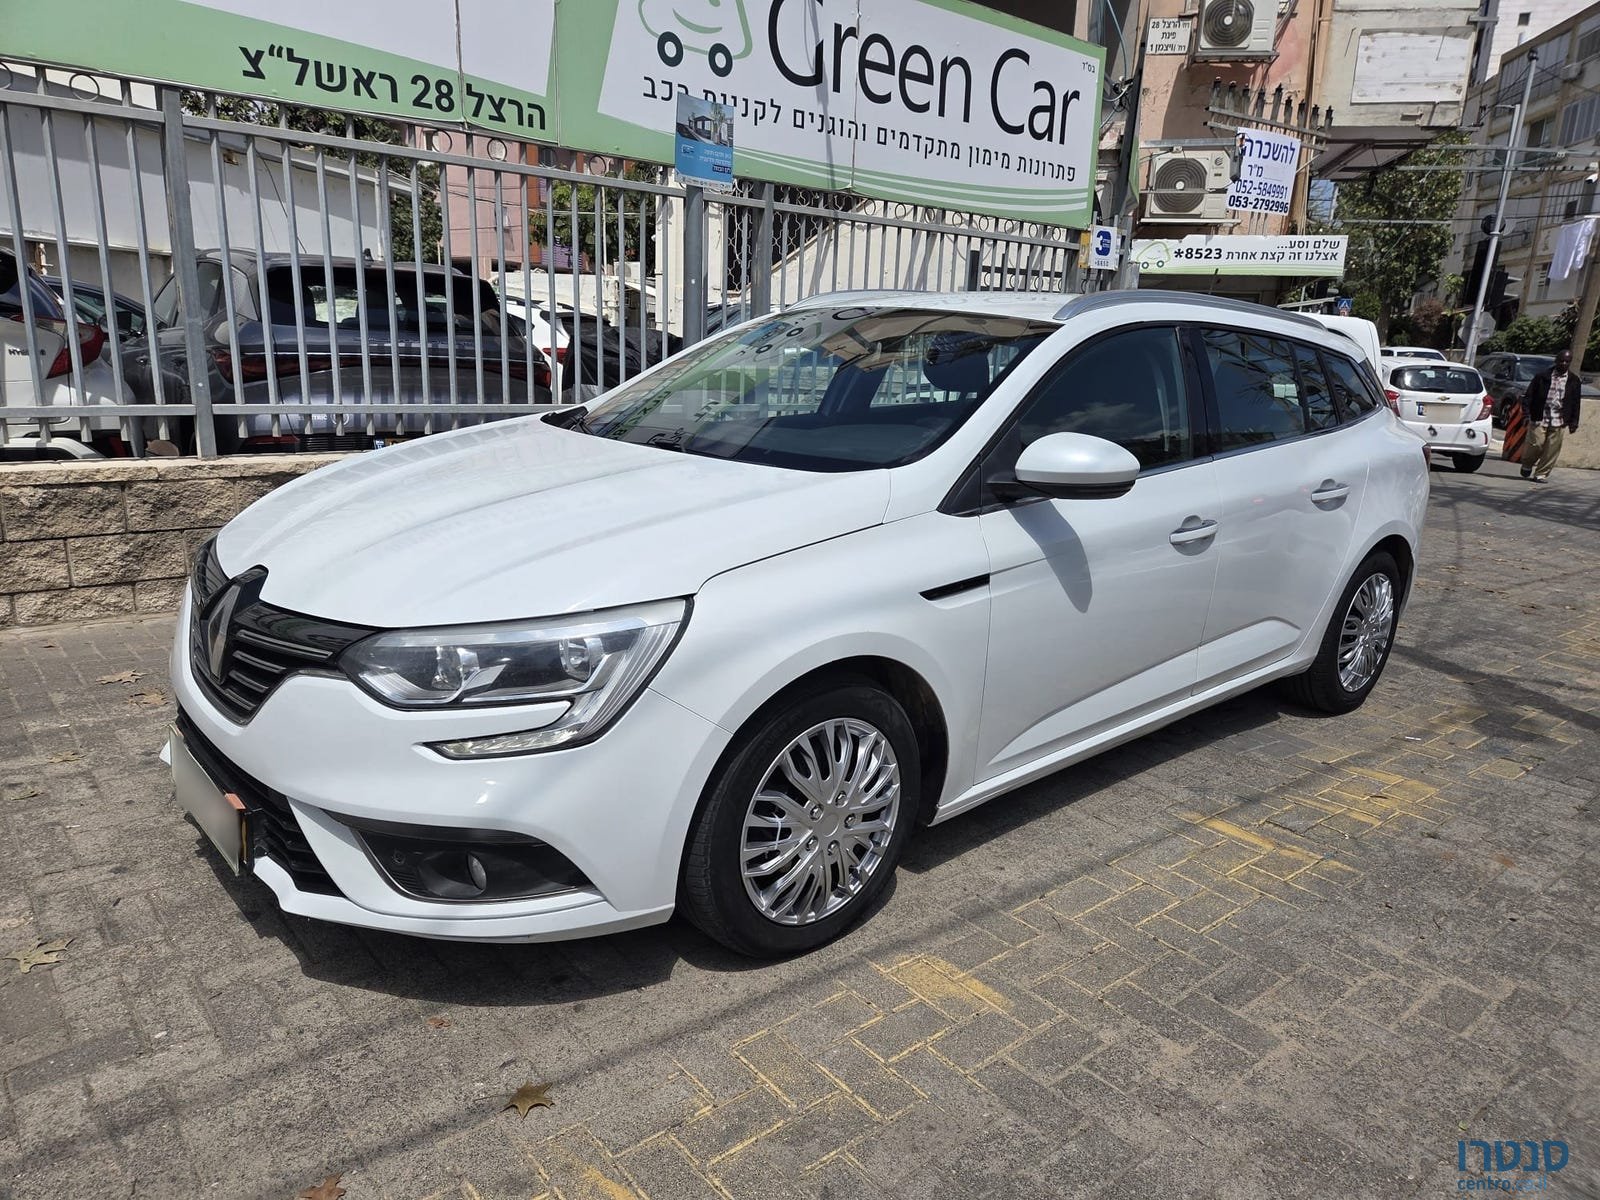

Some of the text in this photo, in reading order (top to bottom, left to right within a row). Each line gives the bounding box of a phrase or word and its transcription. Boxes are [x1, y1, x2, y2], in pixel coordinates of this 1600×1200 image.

[1162, 19, 1180, 28] הרצל
[768, 0, 1080, 146] Green Car
[411, 75, 455, 113] 28
[465, 83, 546, 130] הרצל
[793, 109, 867, 142] והוגנים
[877, 127, 961, 160] מתקדמים
[1244, 138, 1295, 164] להשכרה
[969, 143, 1010, 169] מימון
[1018, 156, 1076, 183] פתרונות
[1235, 179, 1288, 199] 052-5849991
[1228, 195, 1289, 214] 053-2792996
[1226, 250, 1257, 261] אחרת
[1260, 250, 1285, 263] קצת
[1288, 251, 1302, 261] זה
[1305, 250, 1338, 261] אצלנו
[1313, 240, 1340, 250] שלם
